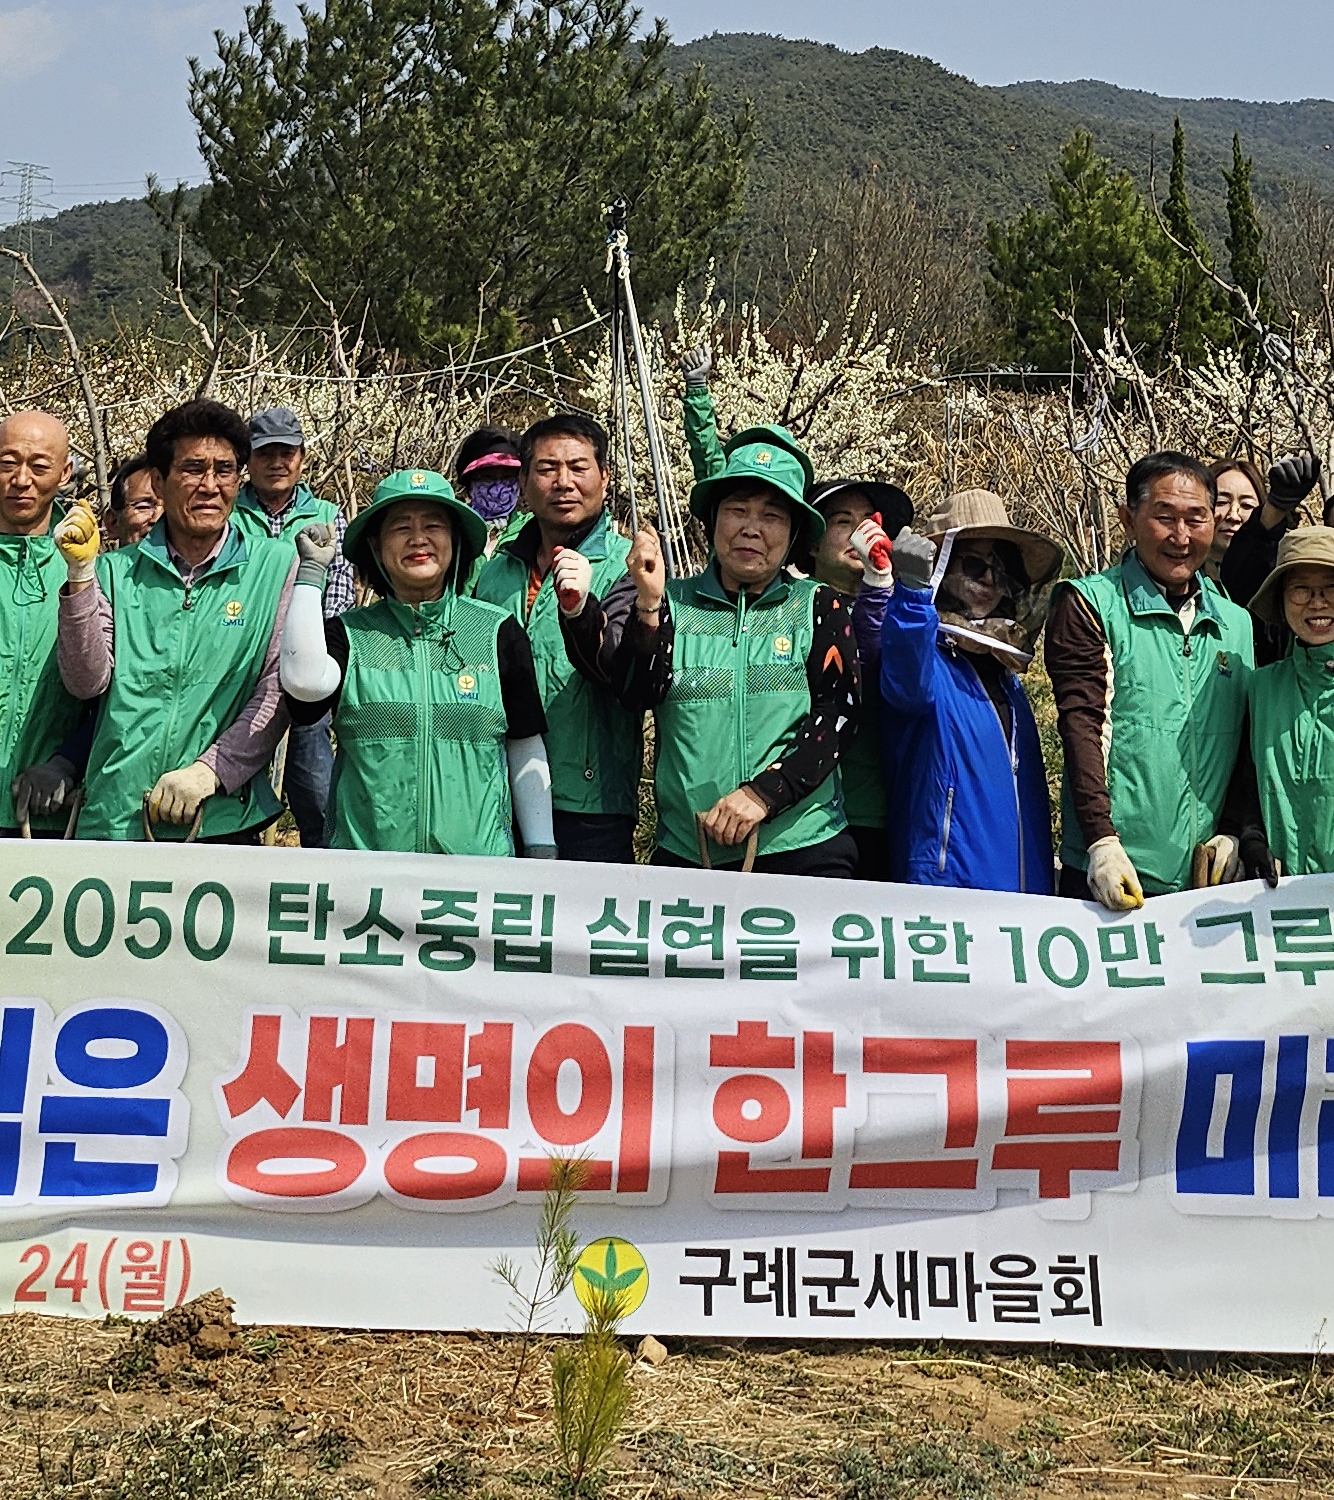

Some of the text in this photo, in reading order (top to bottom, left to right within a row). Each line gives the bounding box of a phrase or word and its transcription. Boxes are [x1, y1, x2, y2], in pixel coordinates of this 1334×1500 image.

[6, 876, 234, 961] 2050
[268, 883, 555, 972] 탄소중립
[587, 898, 798, 980] 실현을
[832, 914, 972, 983] 위한
[1000, 923, 1164, 988] 10만
[223, 1015, 653, 1200] 생명의
[710, 1021, 1122, 1198] 한그루
[16, 1239, 189, 1311] 24(월)
[680, 1247, 1102, 1326] 구례군새마을회
